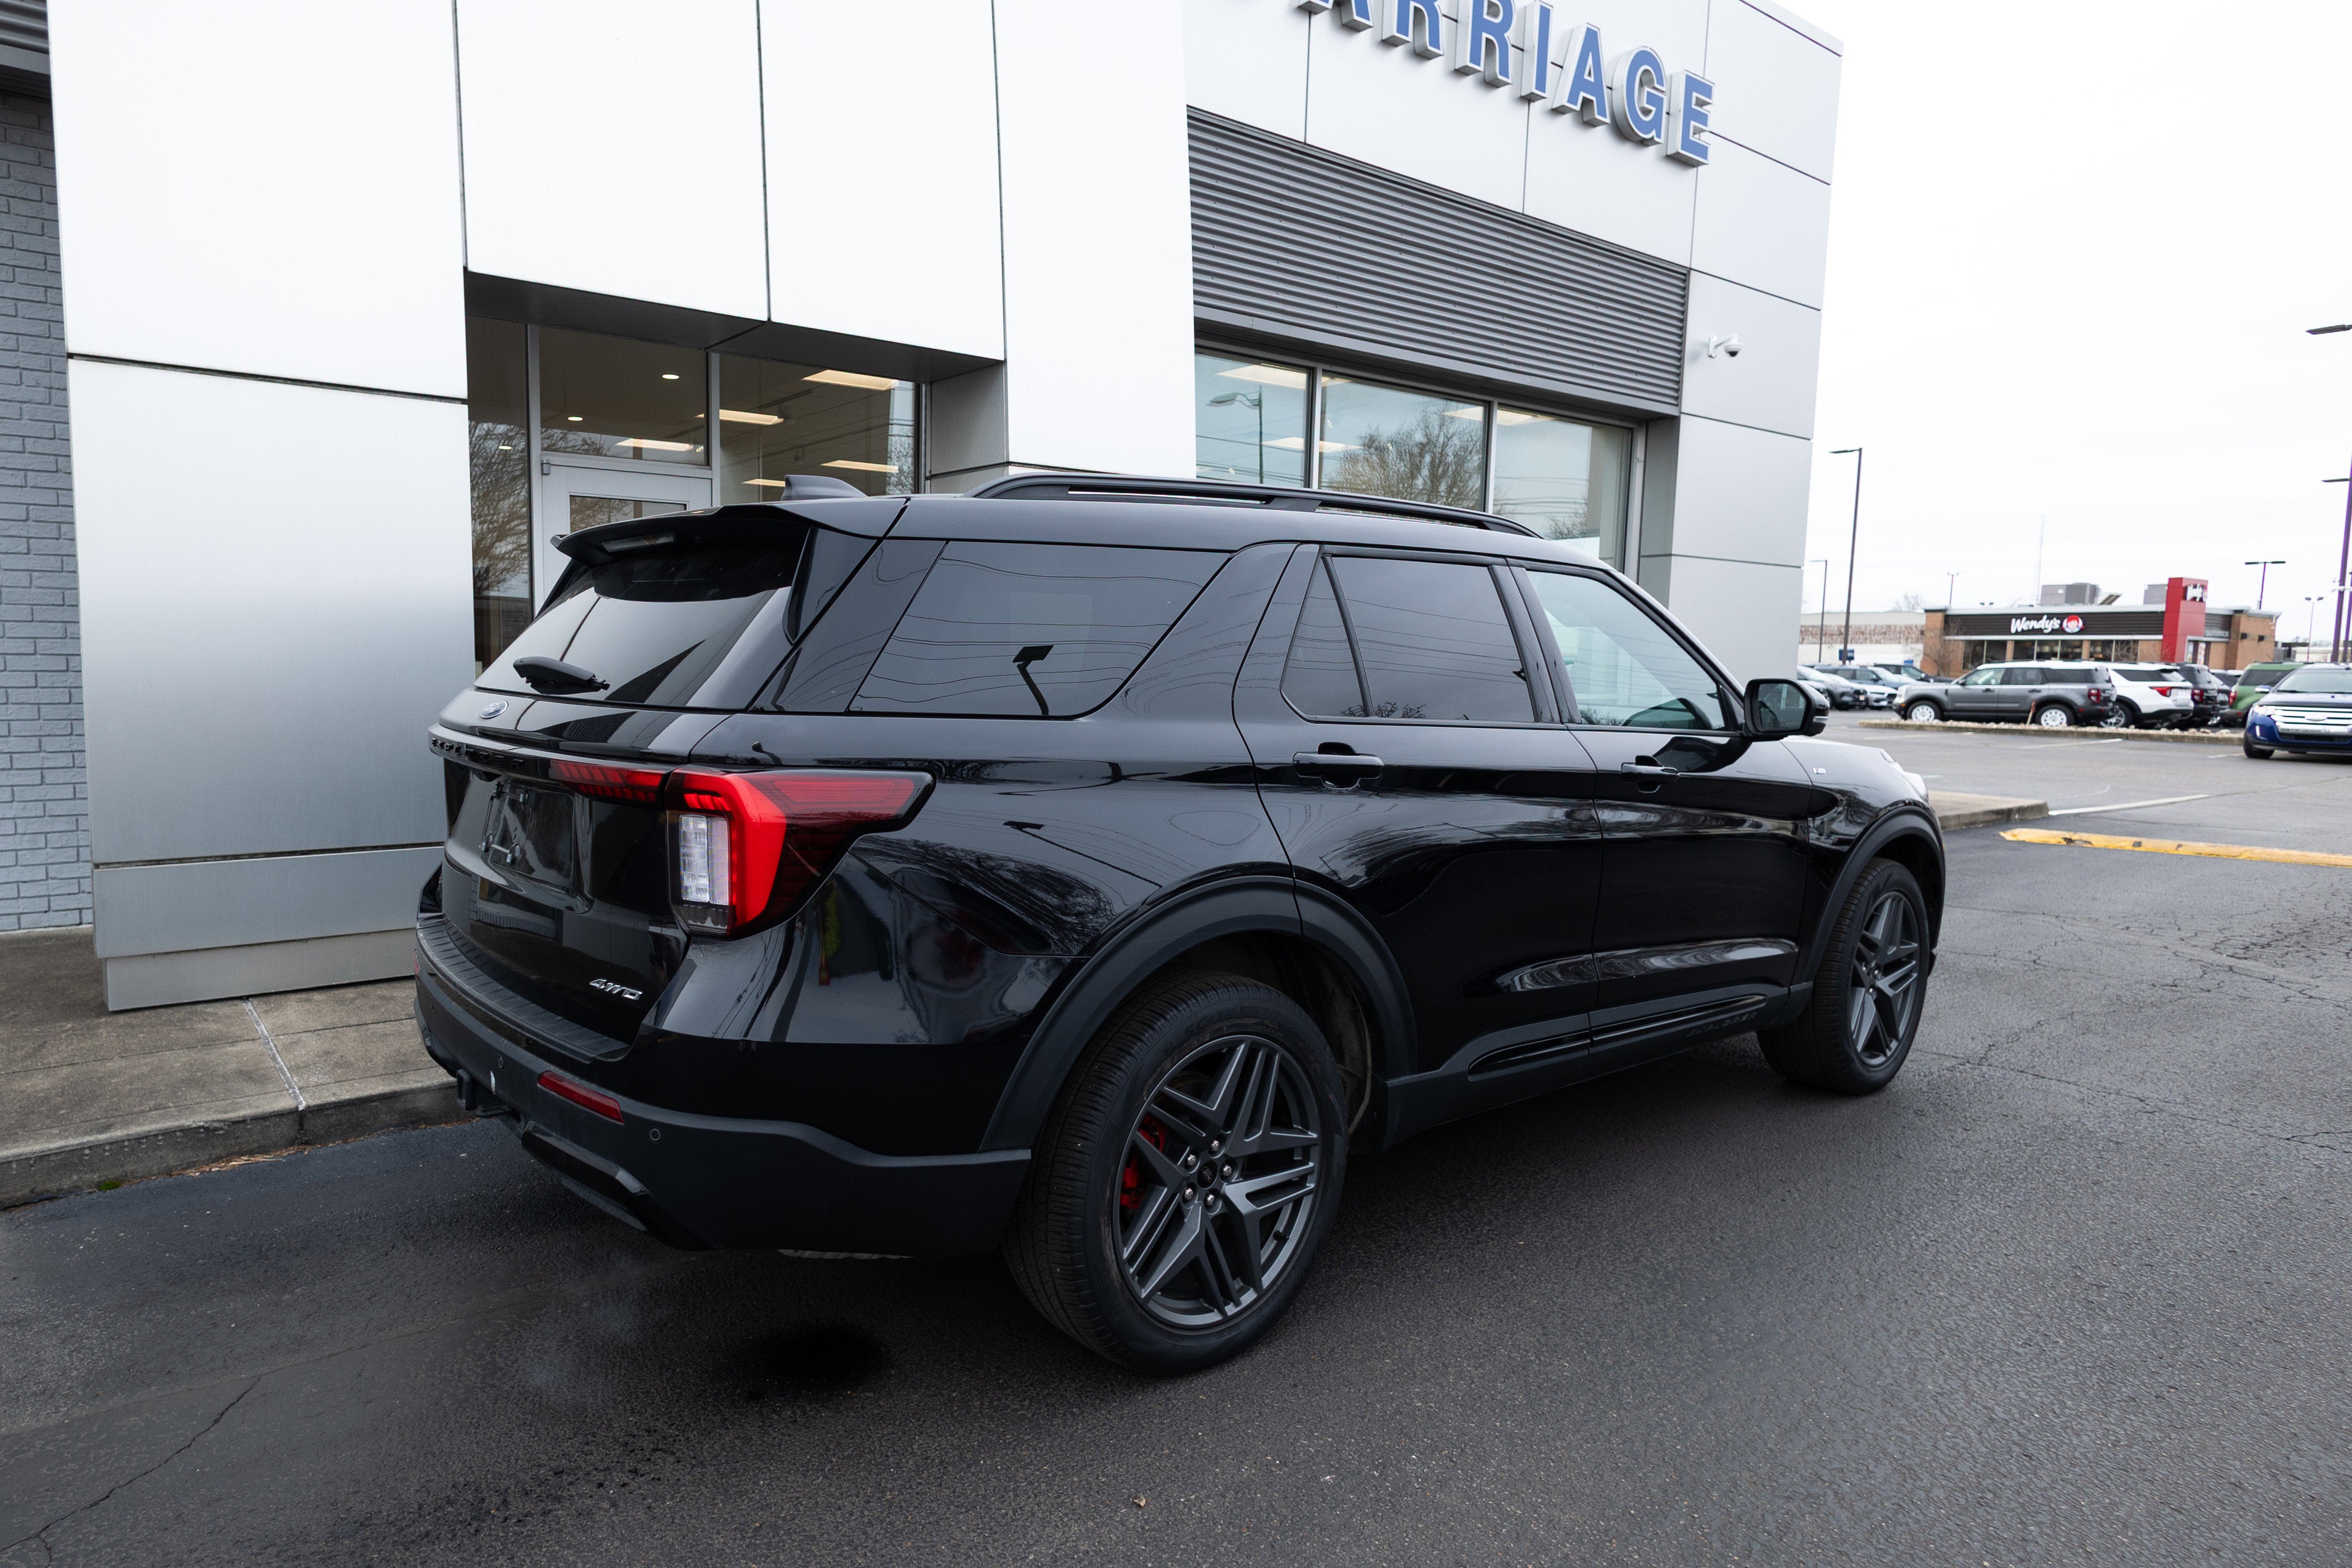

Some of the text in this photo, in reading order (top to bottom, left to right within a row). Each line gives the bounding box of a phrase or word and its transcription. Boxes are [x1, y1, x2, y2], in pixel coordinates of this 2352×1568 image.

[1297, 0, 1714, 167] RIAGE
[2011, 615, 2061, 633] Wendy's
[589, 978, 642, 1000] 4WD
